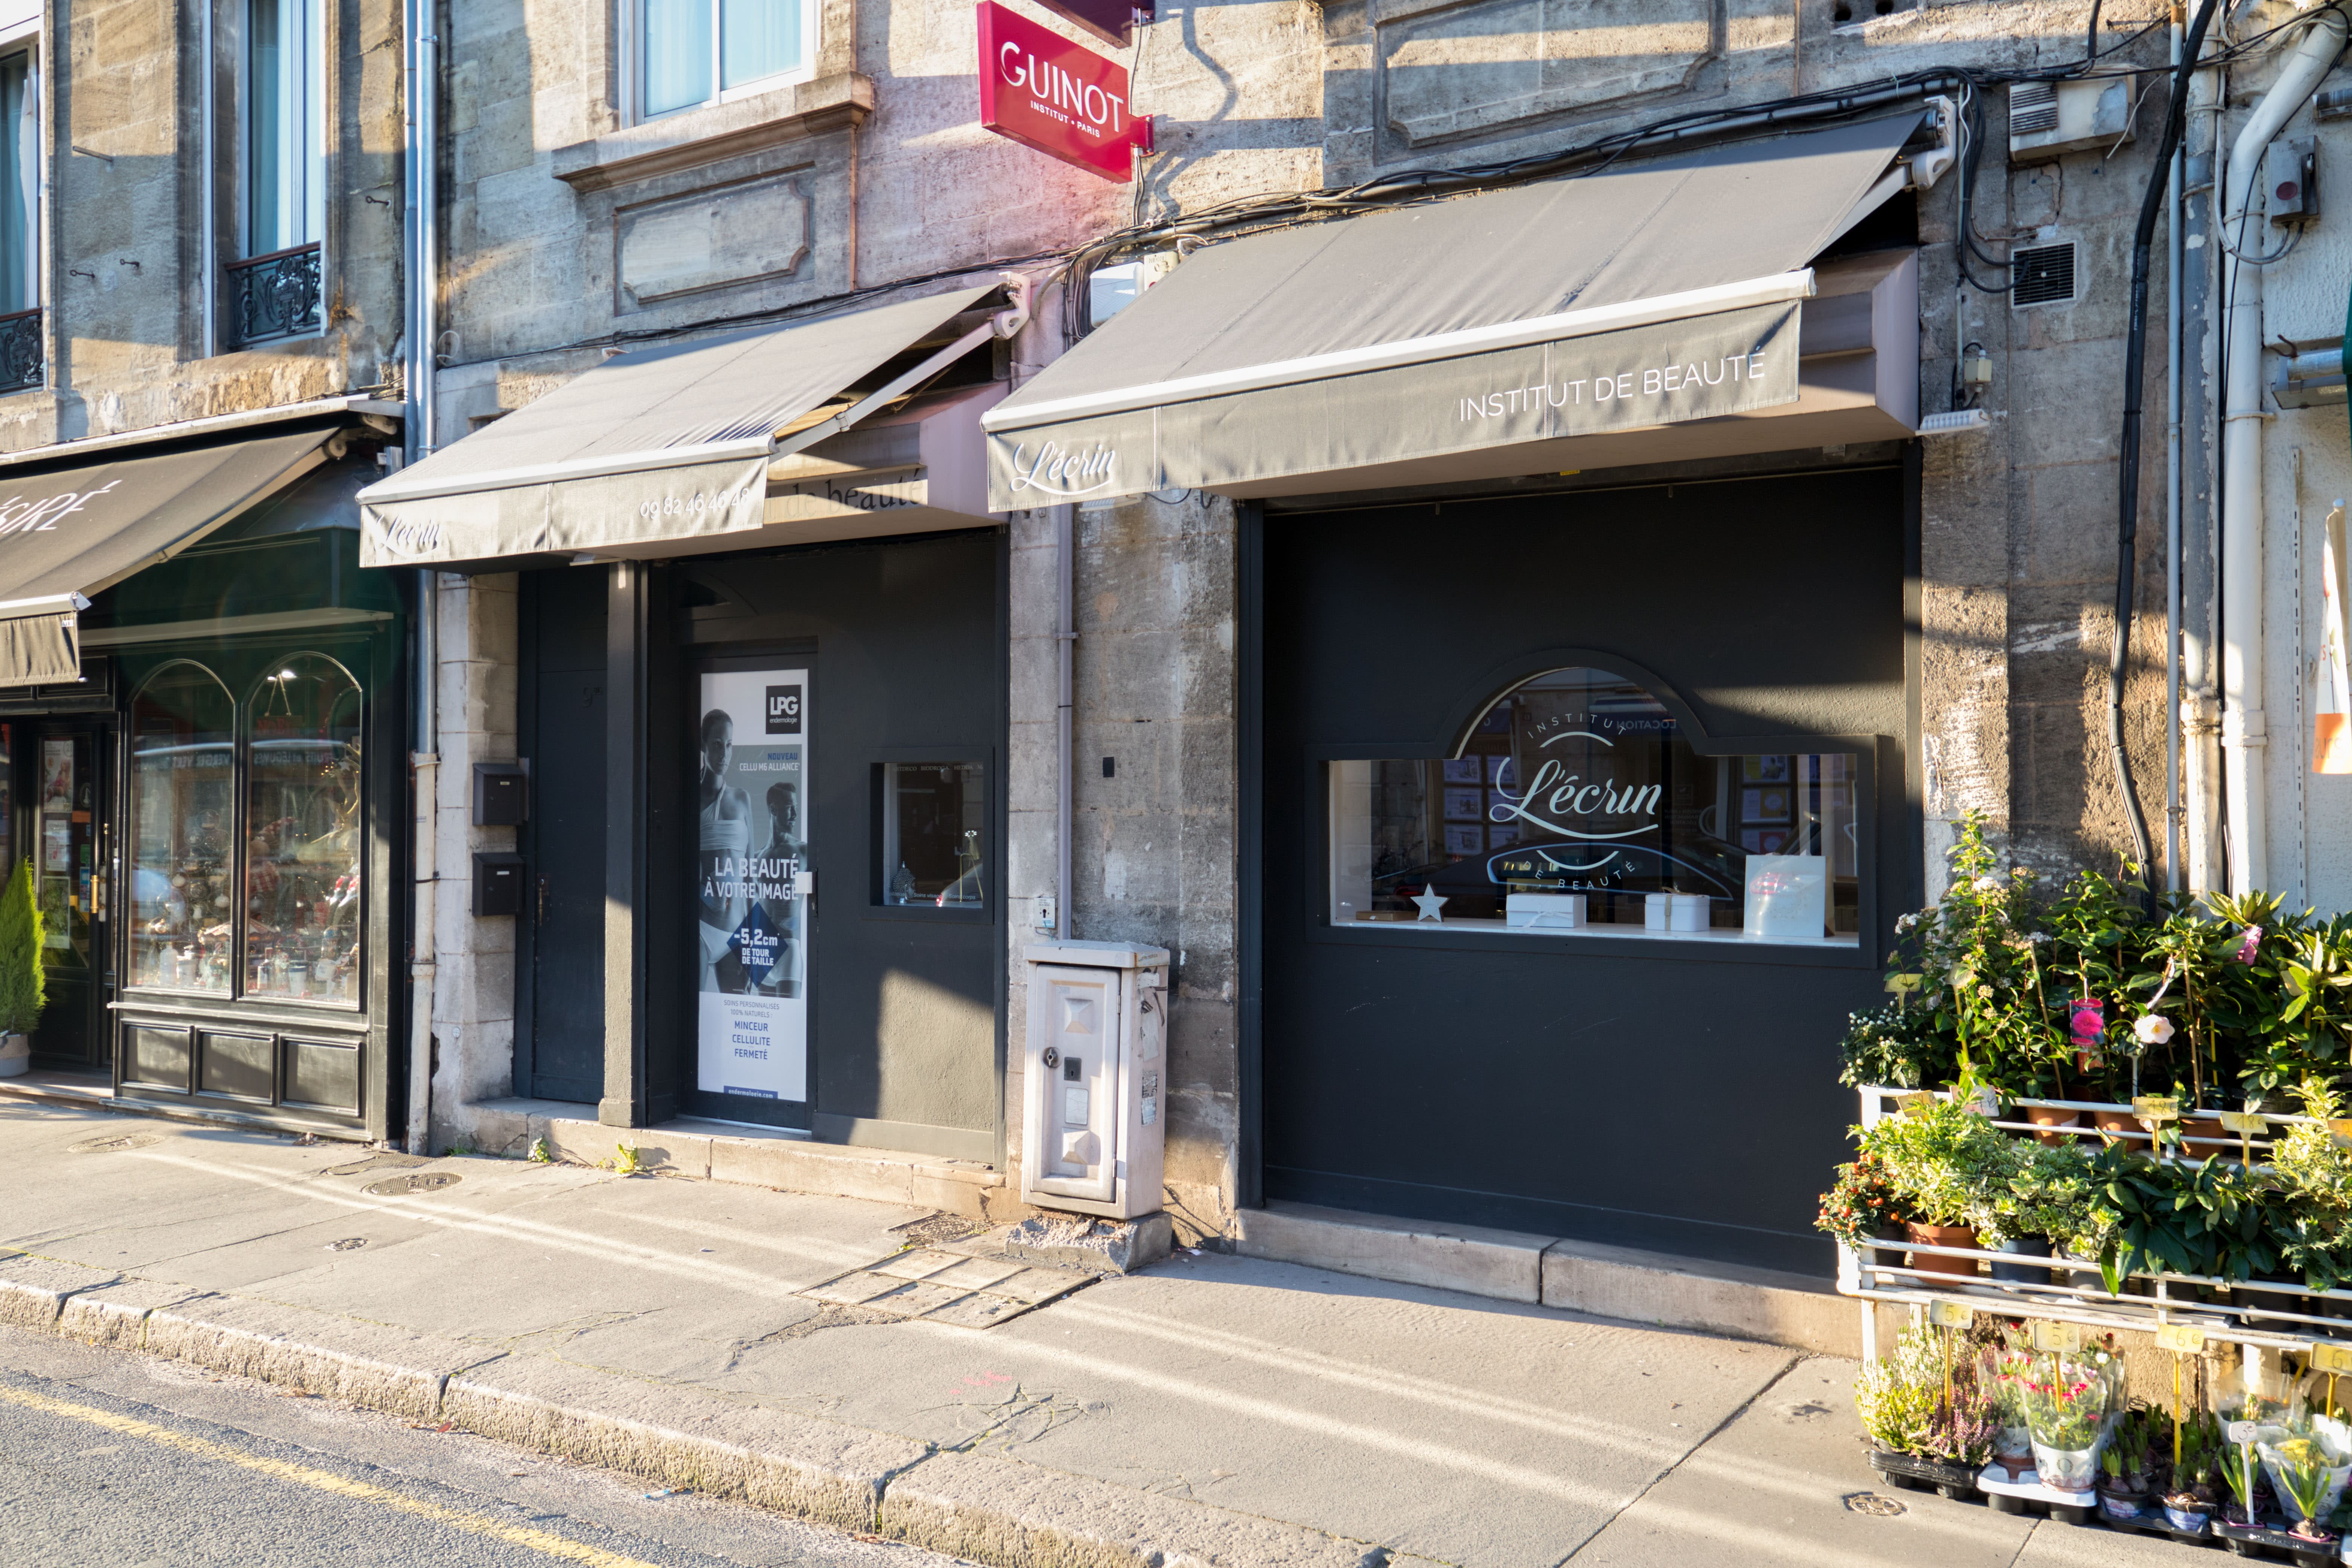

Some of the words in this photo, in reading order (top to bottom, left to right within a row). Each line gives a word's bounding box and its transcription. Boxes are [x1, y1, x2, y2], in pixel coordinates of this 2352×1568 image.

[1001, 41, 1124, 132] GUINOT
[1030, 100, 1069, 125] INSTITUT
[1077, 121, 1100, 138] PARIS
[1460, 380, 1586, 421] INSTITUT
[1595, 373, 1633, 401] DE
[1644, 345, 1766, 395] BEAUTÉ
[1011, 441, 1115, 495] L'écrin
[824, 467, 924, 516] beauté
[640, 500, 660, 521] 09
[663, 495, 681, 515] 82
[684, 493, 705, 516] 46
[708, 490, 726, 513] 46
[731, 487, 750, 507] 48
[770, 696, 799, 715] LPG
[1527, 713, 1627, 739] INSTITUT
[739, 763, 758, 771] CELLU
[758, 763, 767, 771] M6
[1489, 757, 1662, 839] L'écrin
[715, 857, 735, 877] LA
[739, 853, 799, 879] BEAUTÉ
[1522, 860, 1544, 880] DE
[1558, 860, 1636, 890] BEAUTÉ
[704, 877, 714, 897] À
[717, 881, 755, 899] VOTRE
[759, 883, 798, 900] IMAGE
[741, 948, 751, 957] DE
[752, 948, 769, 957] TOUR
[741, 956, 751, 965] DE
[752, 956, 774, 966] TAILLE
[740, 1000, 779, 1010] PERSONNALISÉS
[744, 1009, 770, 1018] NATURELS
[734, 1021, 768, 1032] MINCEUR
[732, 1034, 770, 1046] CELLULITE
[734, 1048, 768, 1060] FERMETÉ
[728, 1088, 773, 1099] endermologie.com
